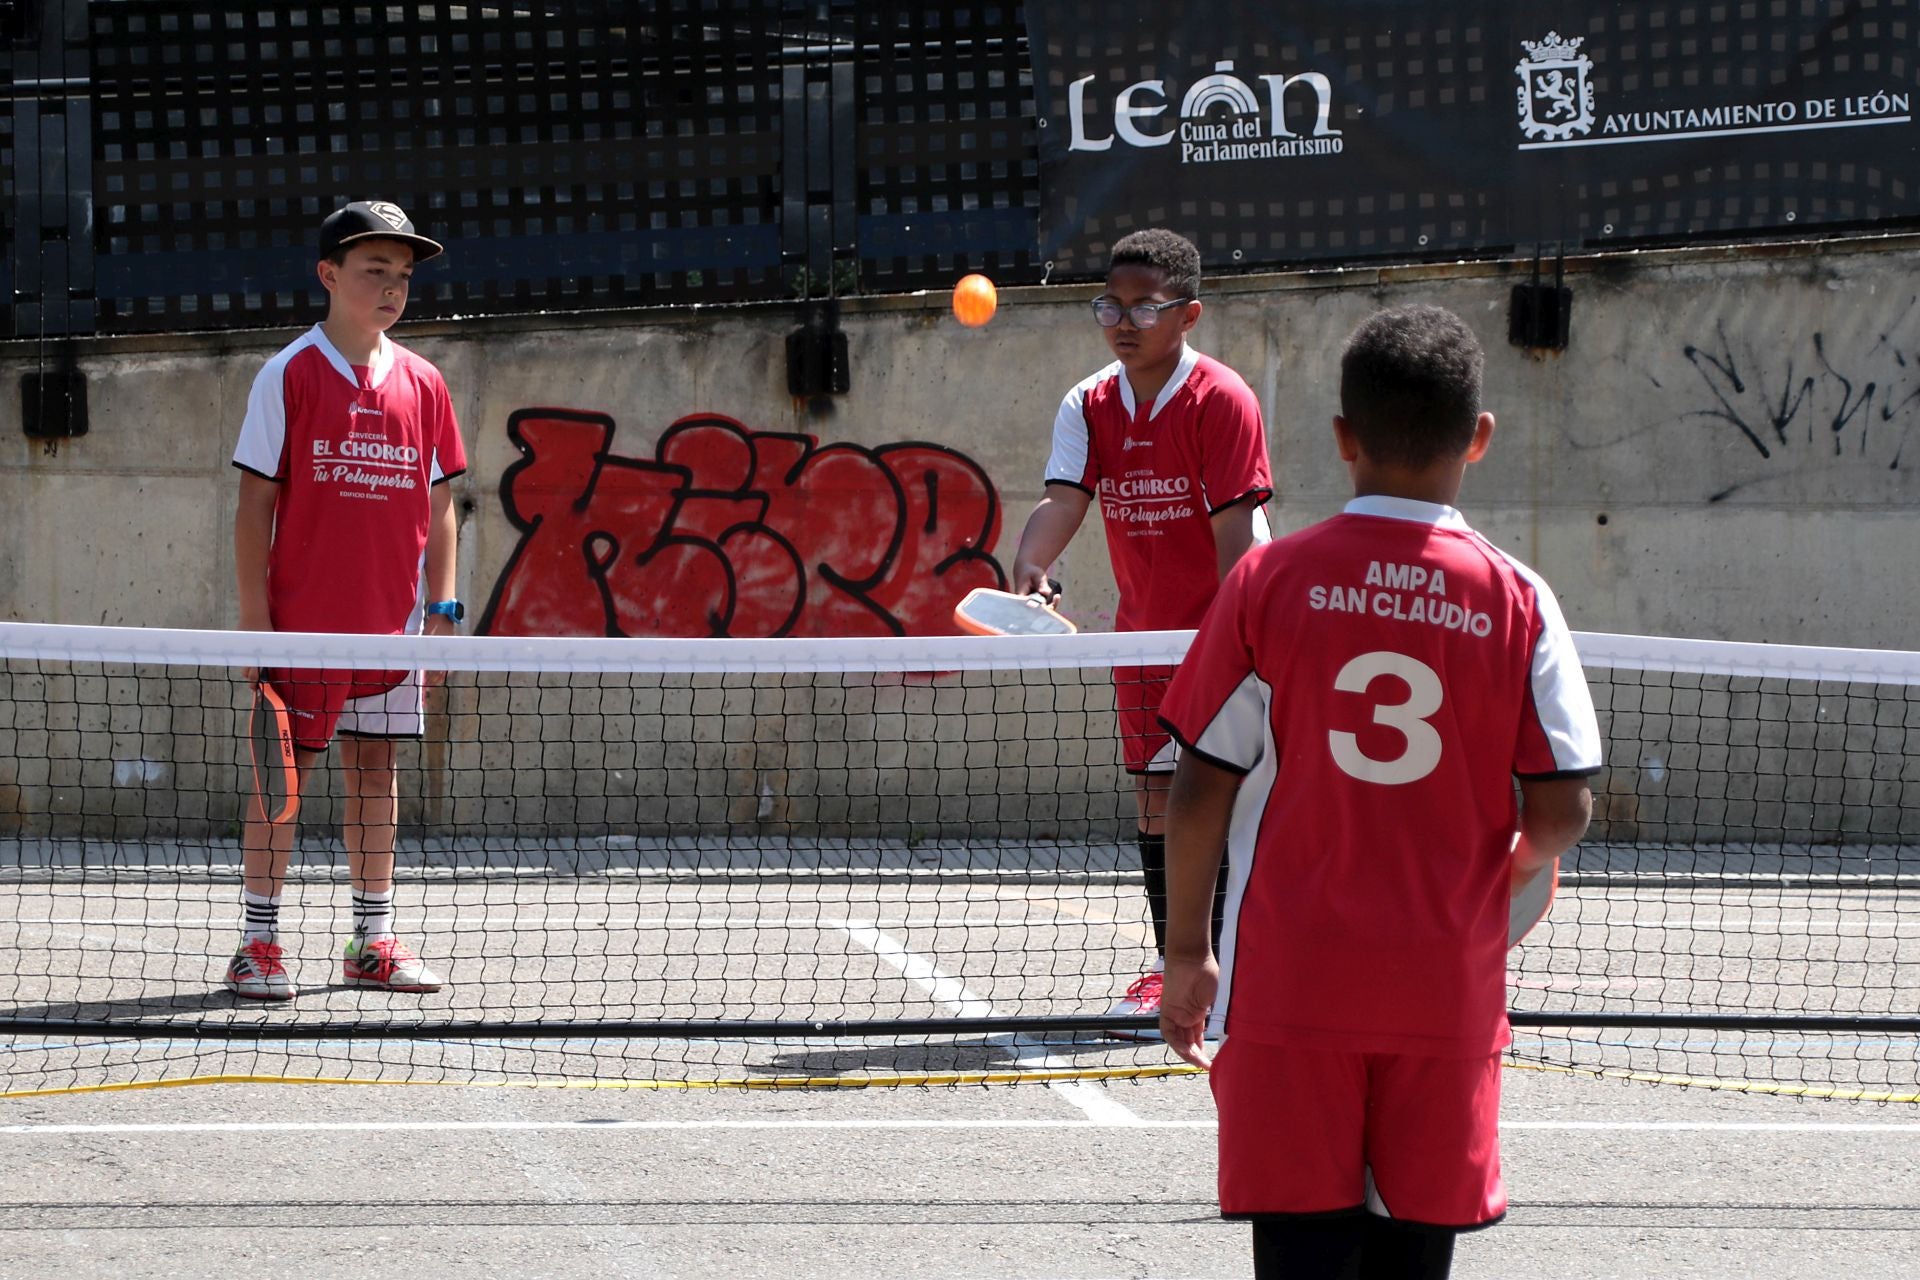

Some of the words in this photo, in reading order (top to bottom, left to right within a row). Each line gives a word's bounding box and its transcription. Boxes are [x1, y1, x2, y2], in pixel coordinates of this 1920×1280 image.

[1603, 102, 1796, 134] AYUNTAMIENTO
[1805, 98, 1837, 119] DE
[1845, 90, 1910, 116] LEÓN
[1180, 121, 1228, 142] Cuna
[1232, 117, 1262, 139] del
[1181, 136, 1344, 164] Parlamentarismo
[313, 439, 333, 456] EL
[340, 440, 418, 463] CHORCO
[312, 465, 330, 482] Tu
[332, 465, 416, 491] Peluquería
[1101, 478, 1119, 494] EL
[1104, 503, 1119, 519] Tu
[1365, 560, 1446, 596] AMPA
[1309, 585, 1367, 615] SAN
[1372, 592, 1493, 637] CLAUDIO
[1328, 650, 1444, 786] 3
